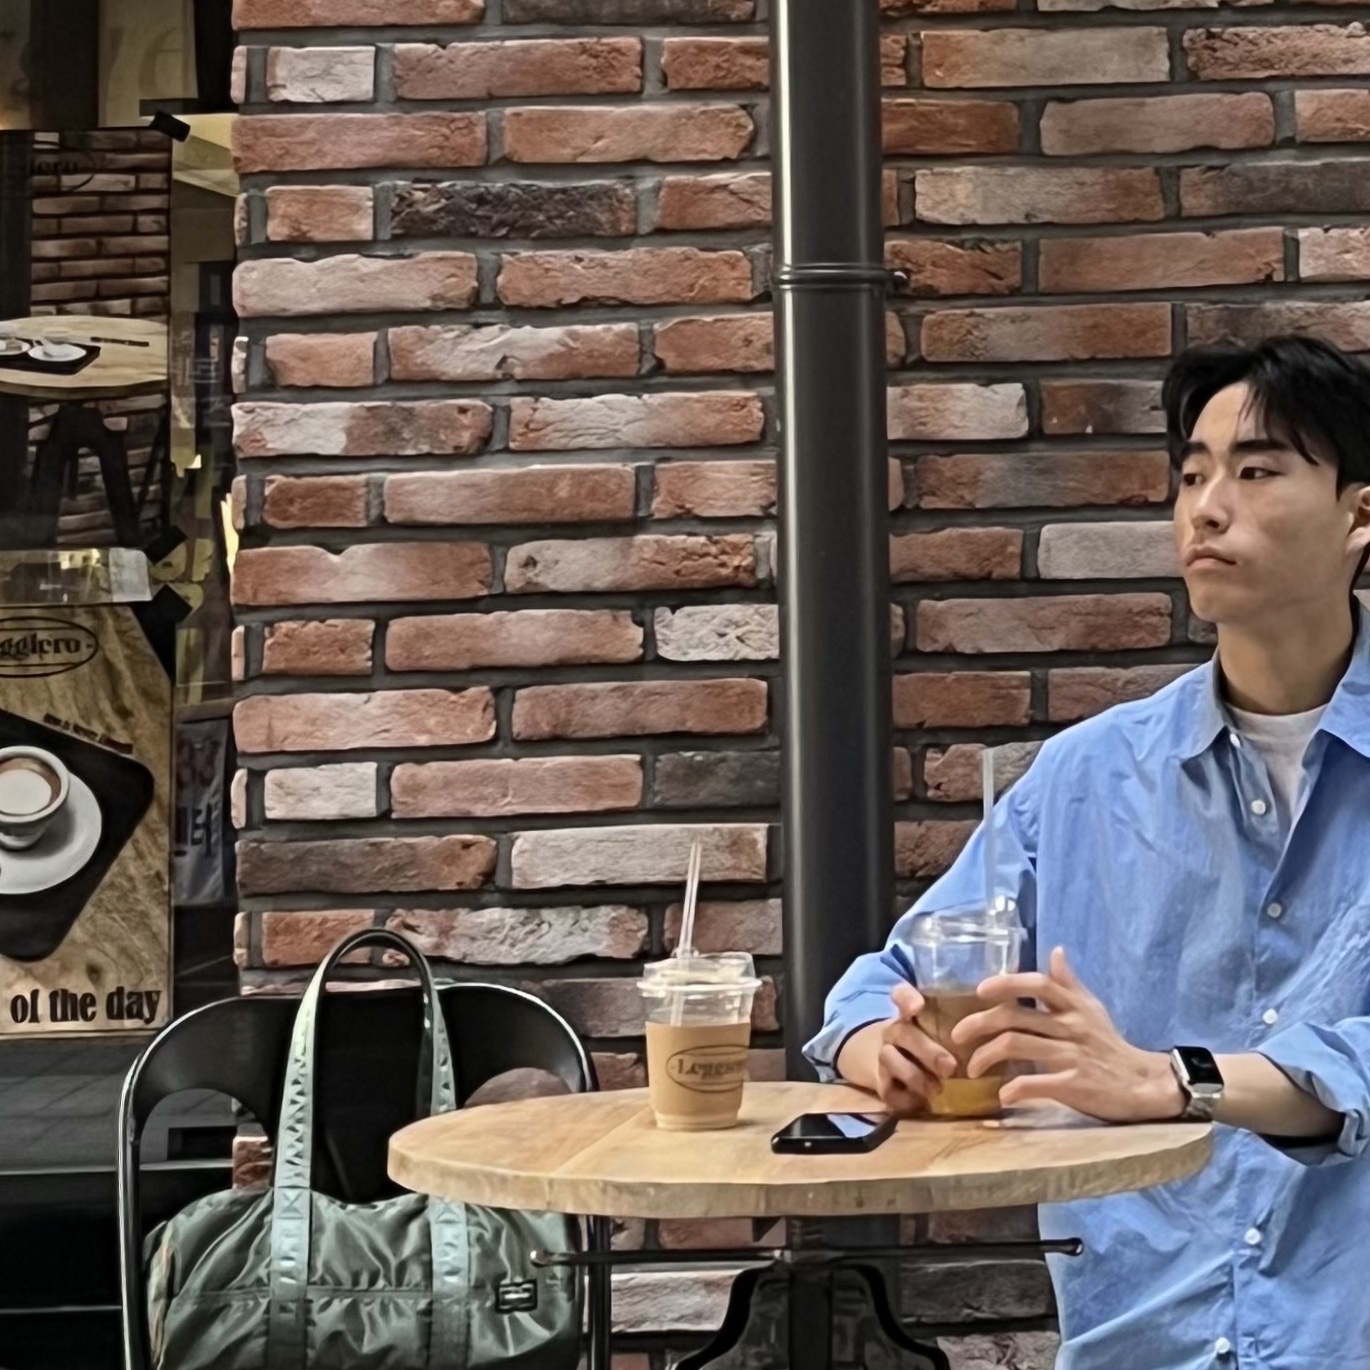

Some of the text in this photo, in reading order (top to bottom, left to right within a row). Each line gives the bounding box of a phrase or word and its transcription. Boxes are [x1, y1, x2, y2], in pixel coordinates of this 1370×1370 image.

[10, 986, 162, 1024] of the day
